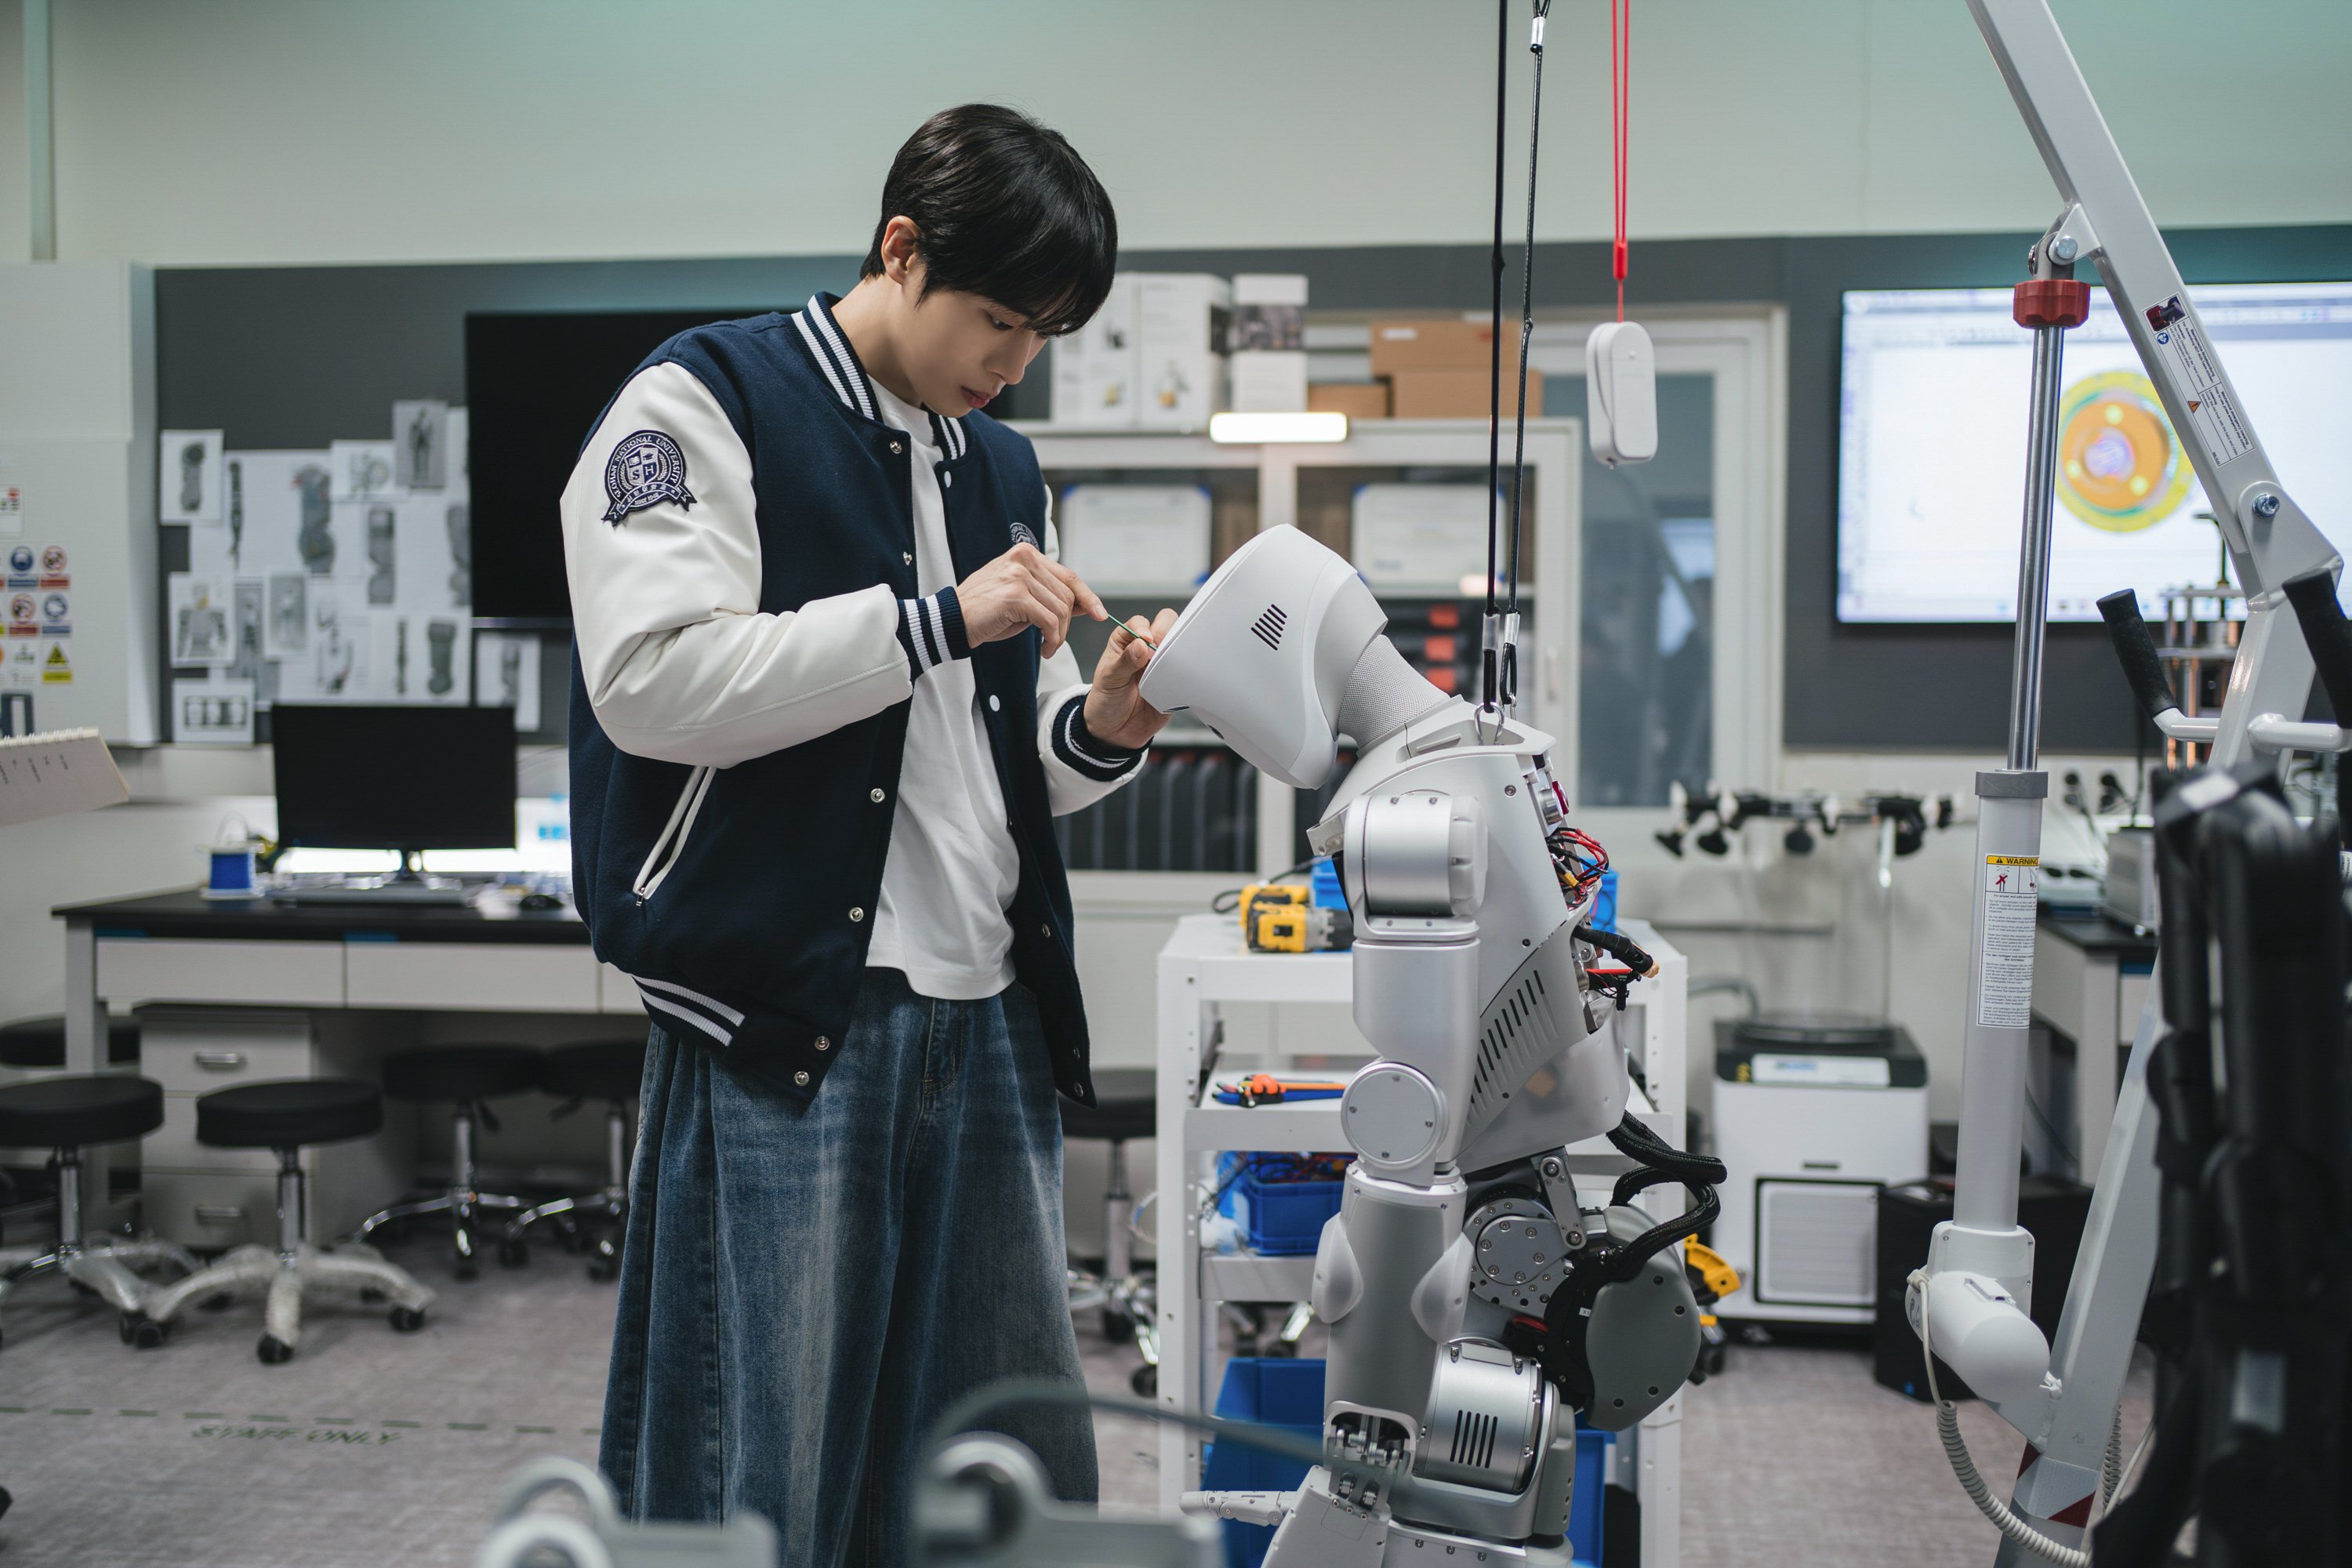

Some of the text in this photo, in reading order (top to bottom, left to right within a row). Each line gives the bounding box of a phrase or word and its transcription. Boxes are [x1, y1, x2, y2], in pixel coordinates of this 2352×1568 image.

[2208, 389, 2218, 405] Lowering
[2221, 391, 2249, 445] Mechanical emergency lowering
[615, 435, 652, 462] NATIONAL
[656, 437, 680, 484] UNIVERSITY
[633, 470, 640, 481] S
[644, 465, 654, 476] H
[191, 1425, 401, 1446] STAFF ONLY
